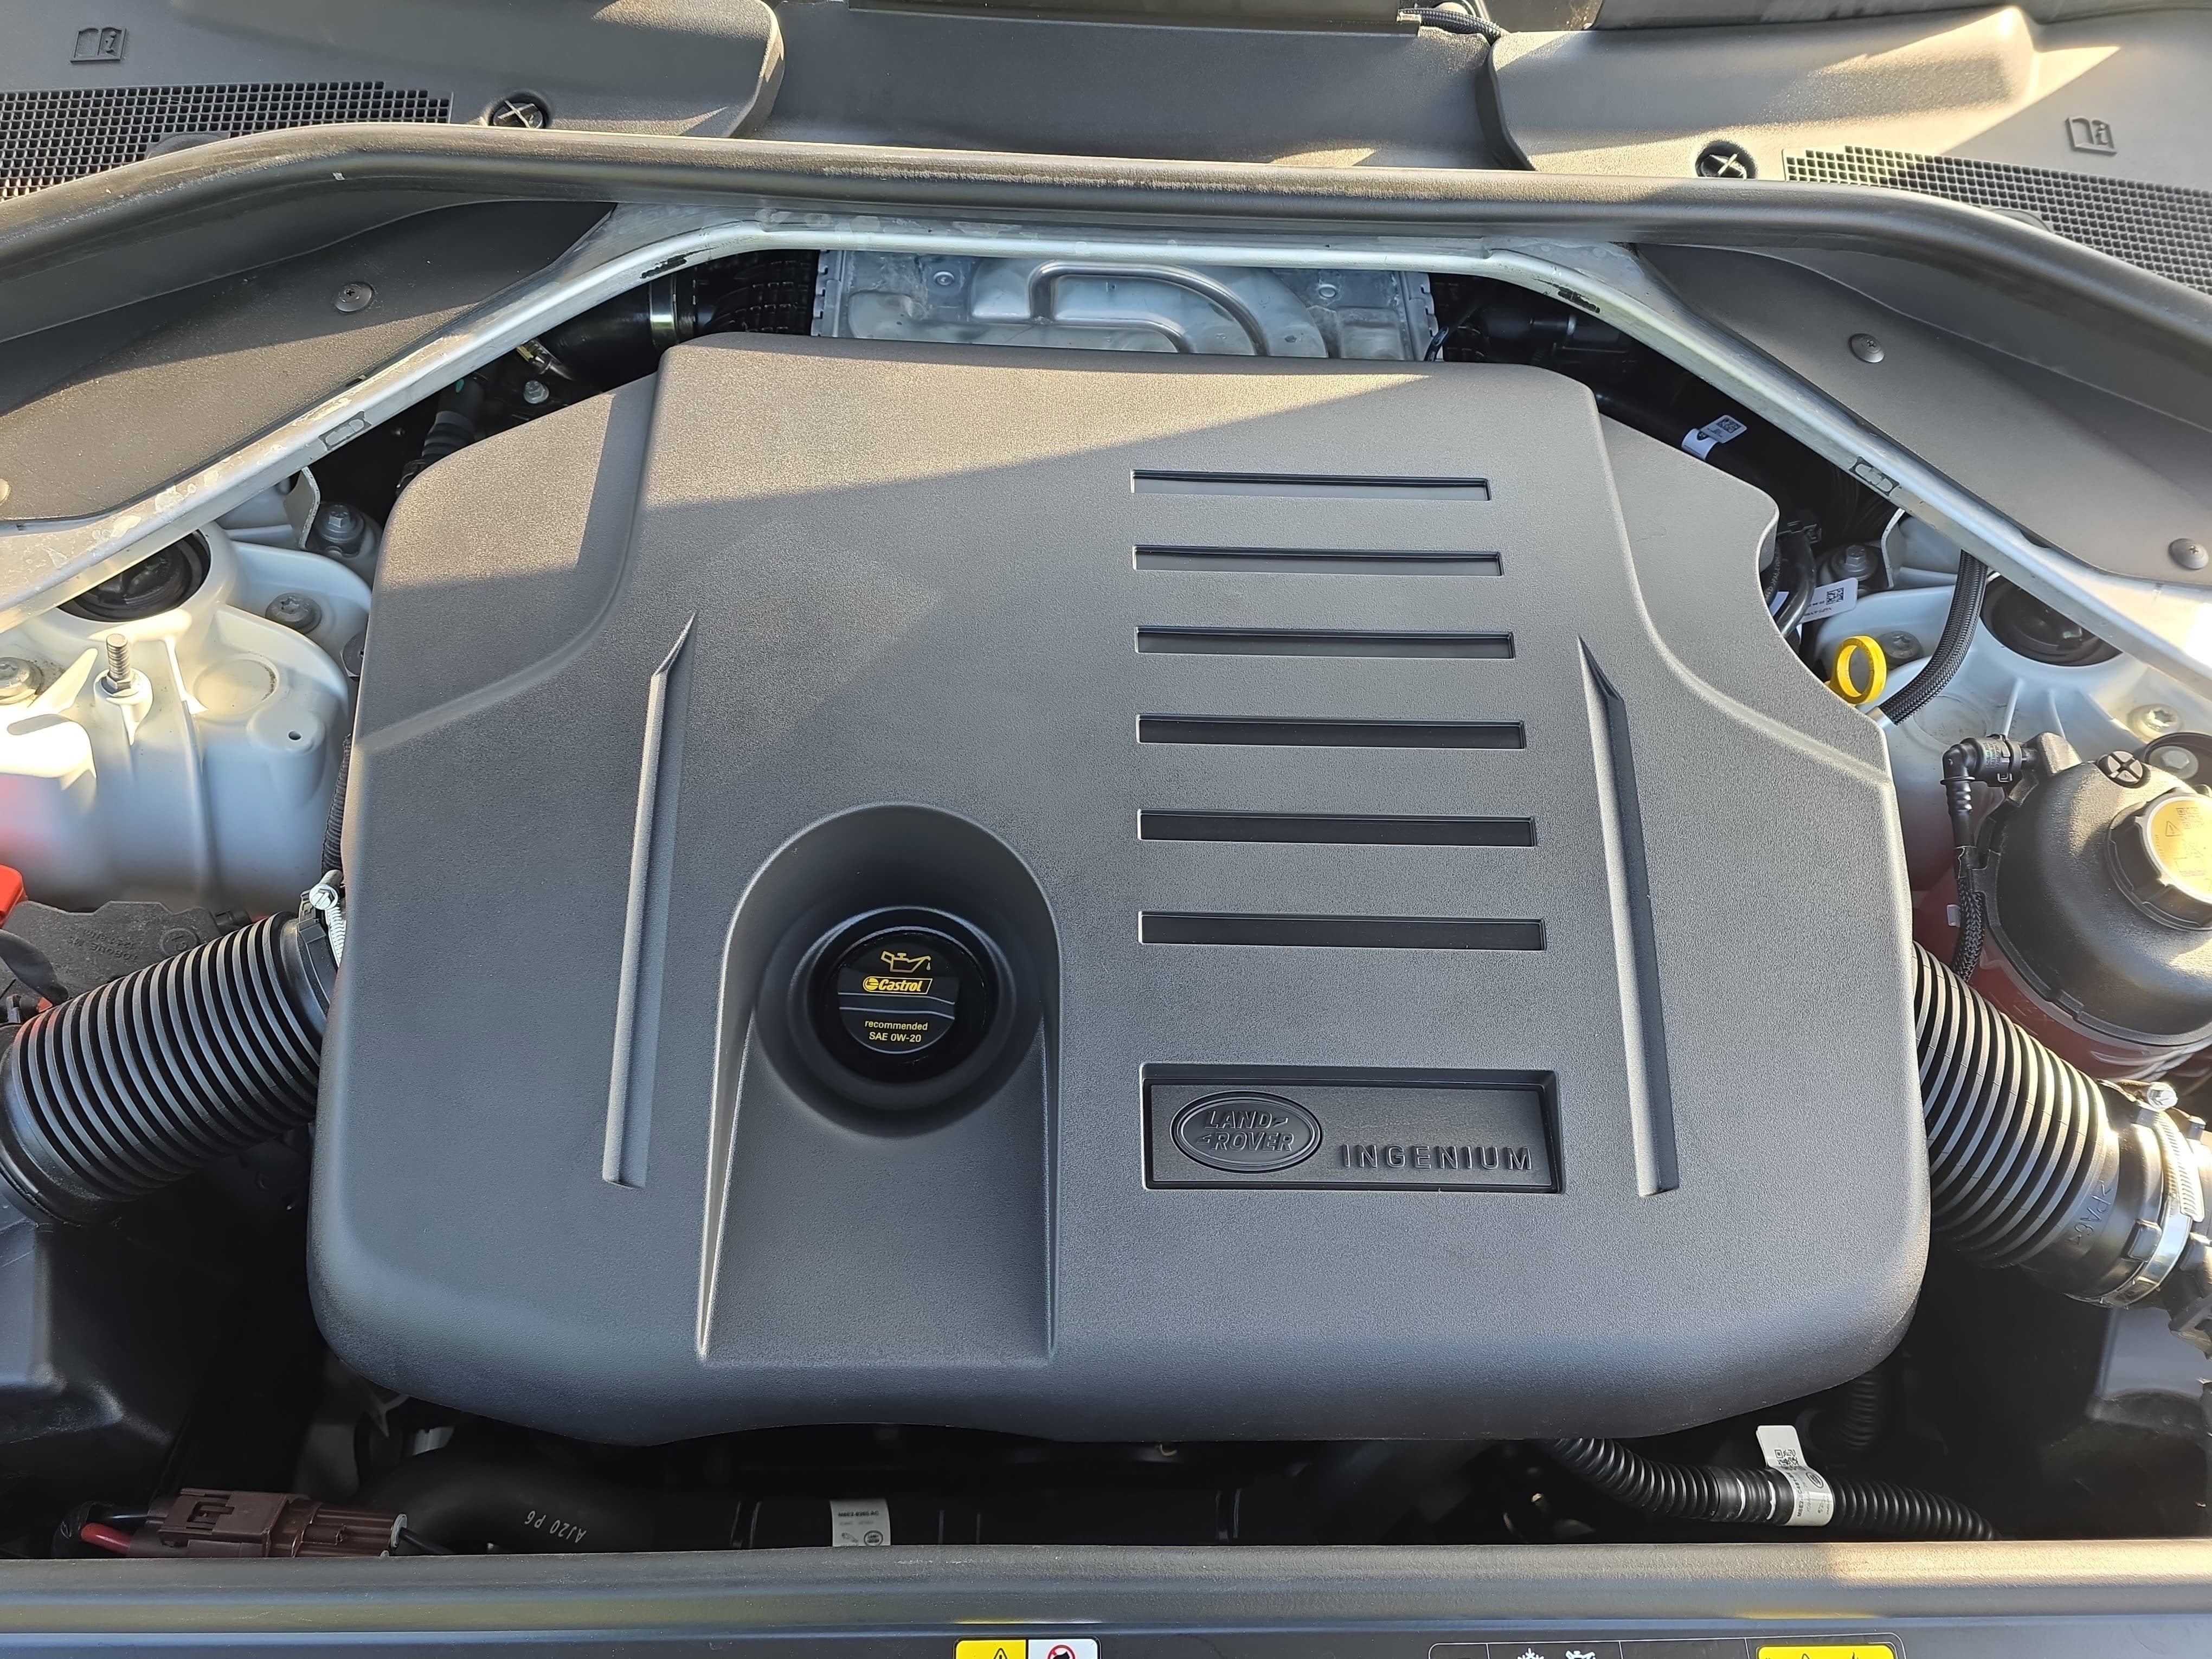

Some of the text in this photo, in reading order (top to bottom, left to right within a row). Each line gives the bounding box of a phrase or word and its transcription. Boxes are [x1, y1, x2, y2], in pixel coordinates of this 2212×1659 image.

[879, 979, 923, 992] Castrol
[865, 1021, 928, 1031] recommended
[869, 1032, 922, 1043] SAE 0W-20
[1341, 1144, 1532, 1170] INGENIUM
[524, 1510, 587, 1543] AJ20 P6
